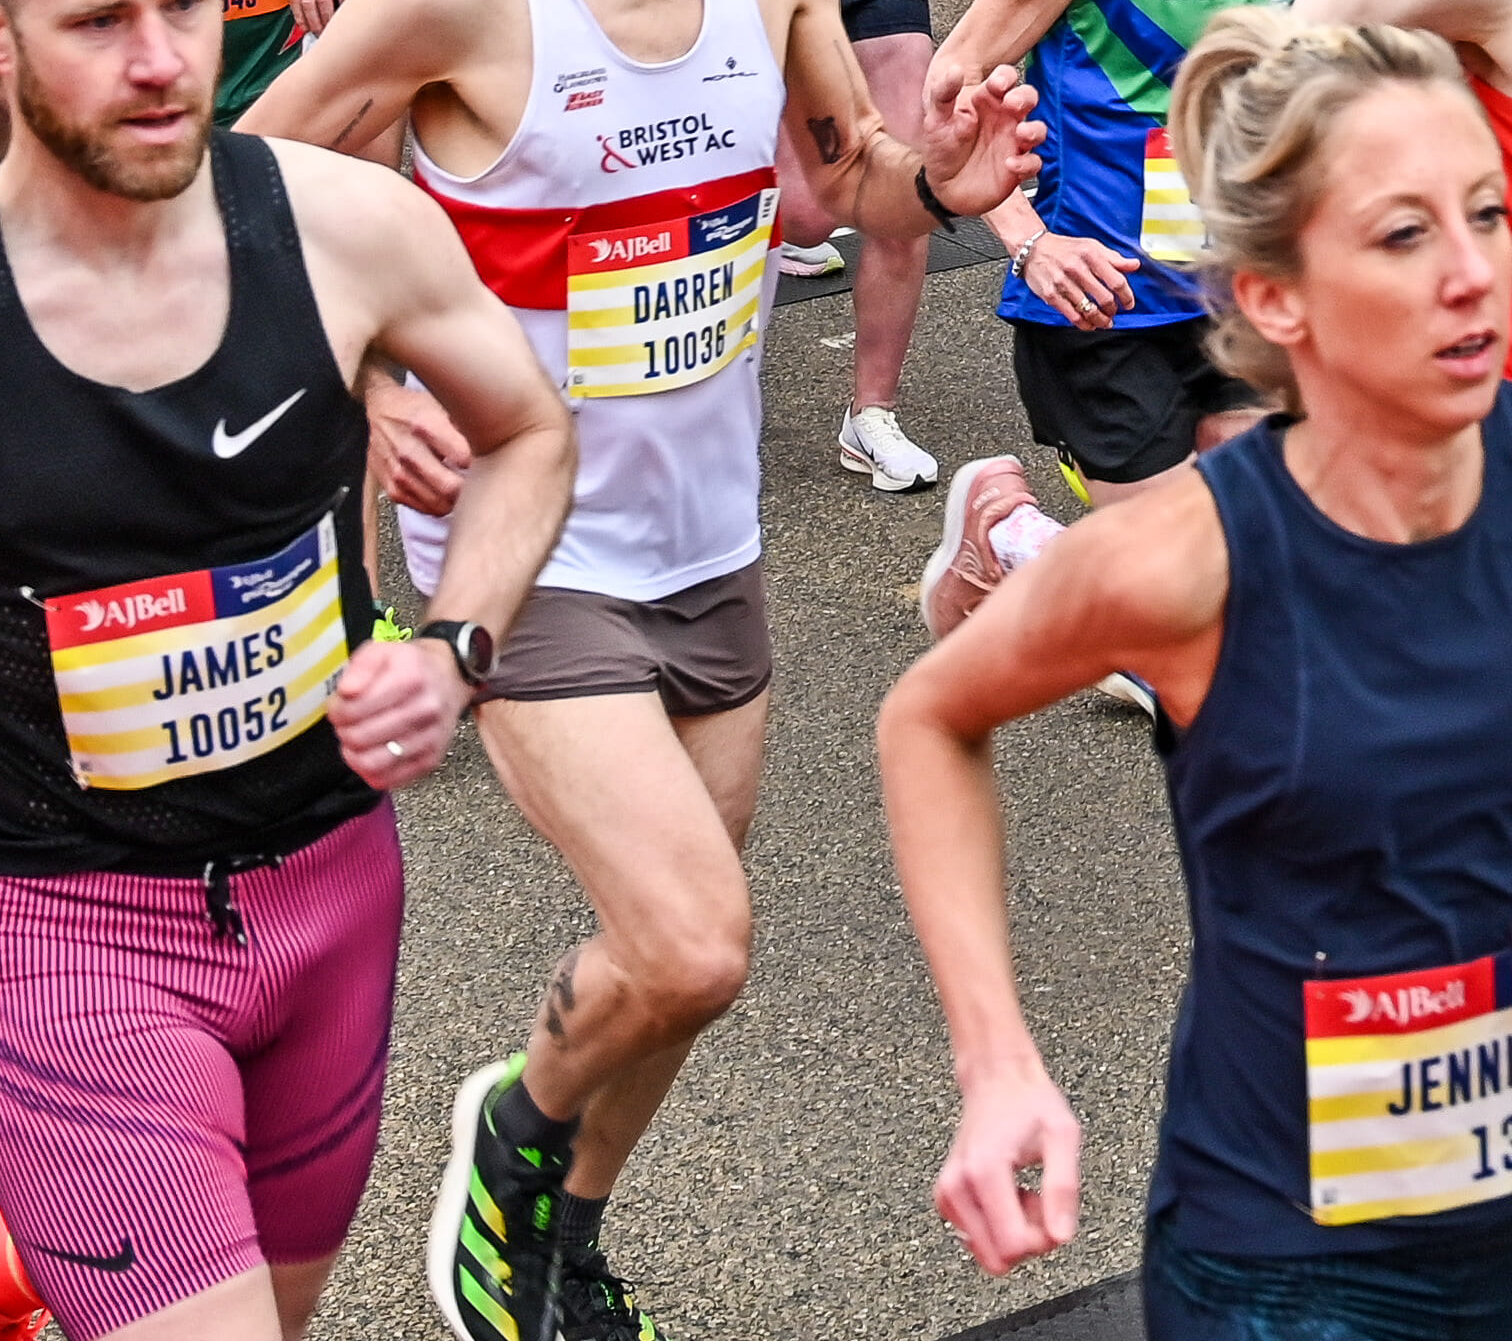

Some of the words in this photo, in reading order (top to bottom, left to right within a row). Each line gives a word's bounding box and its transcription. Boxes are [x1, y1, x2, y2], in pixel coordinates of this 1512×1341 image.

[619, 113, 714, 149] BRISTOL
[635, 138, 696, 167] WEST
[705, 128, 736, 153] AC
[611, 230, 672, 266] AJBell
[633, 261, 734, 324] DARREN
[644, 320, 726, 379] 10036
[103, 587, 186, 632] AJBell
[151, 623, 284, 702] JAMES
[161, 686, 289, 765] 10052
[1374, 980, 1467, 1023] AJBell
